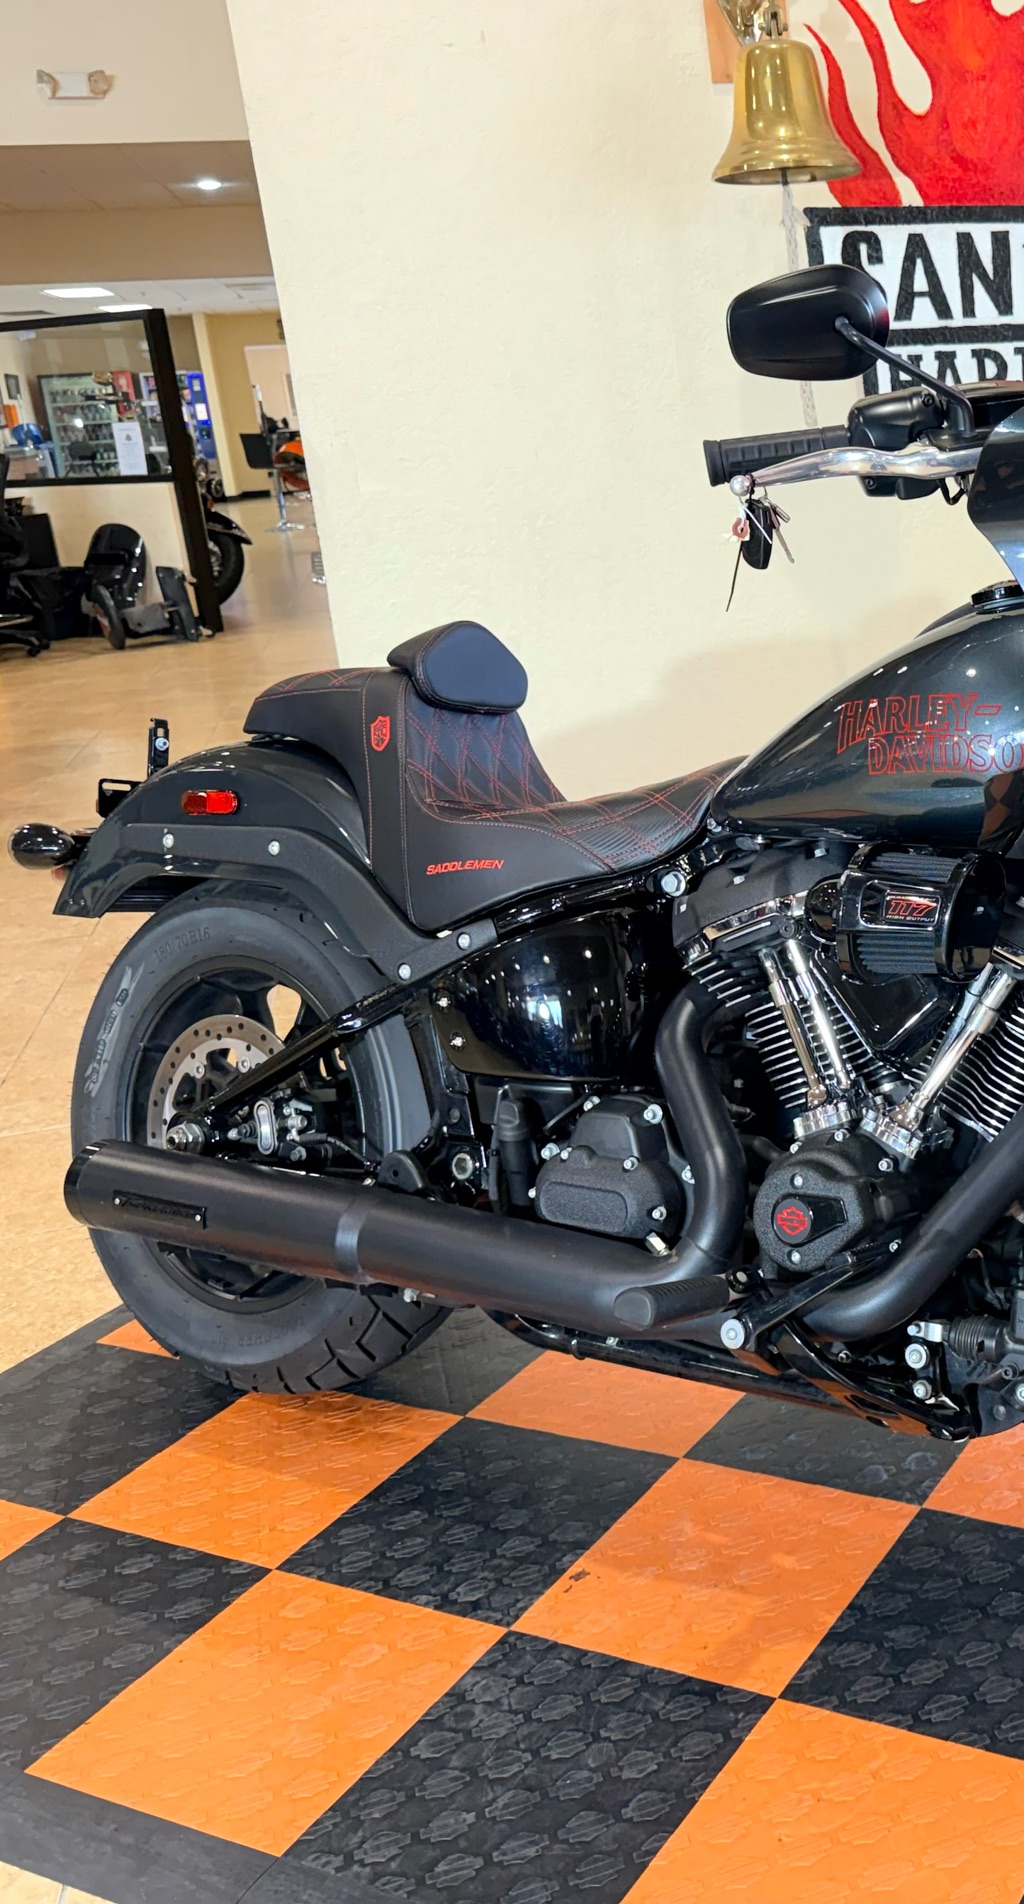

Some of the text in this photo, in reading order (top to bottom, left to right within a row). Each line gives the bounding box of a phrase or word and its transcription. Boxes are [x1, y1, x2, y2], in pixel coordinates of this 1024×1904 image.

[841, 230, 1013, 323] SAN
[837, 692, 1002, 755] HARLEY-
[426, 859, 504, 875] SADDLEMEN
[888, 899, 936, 917] 117
